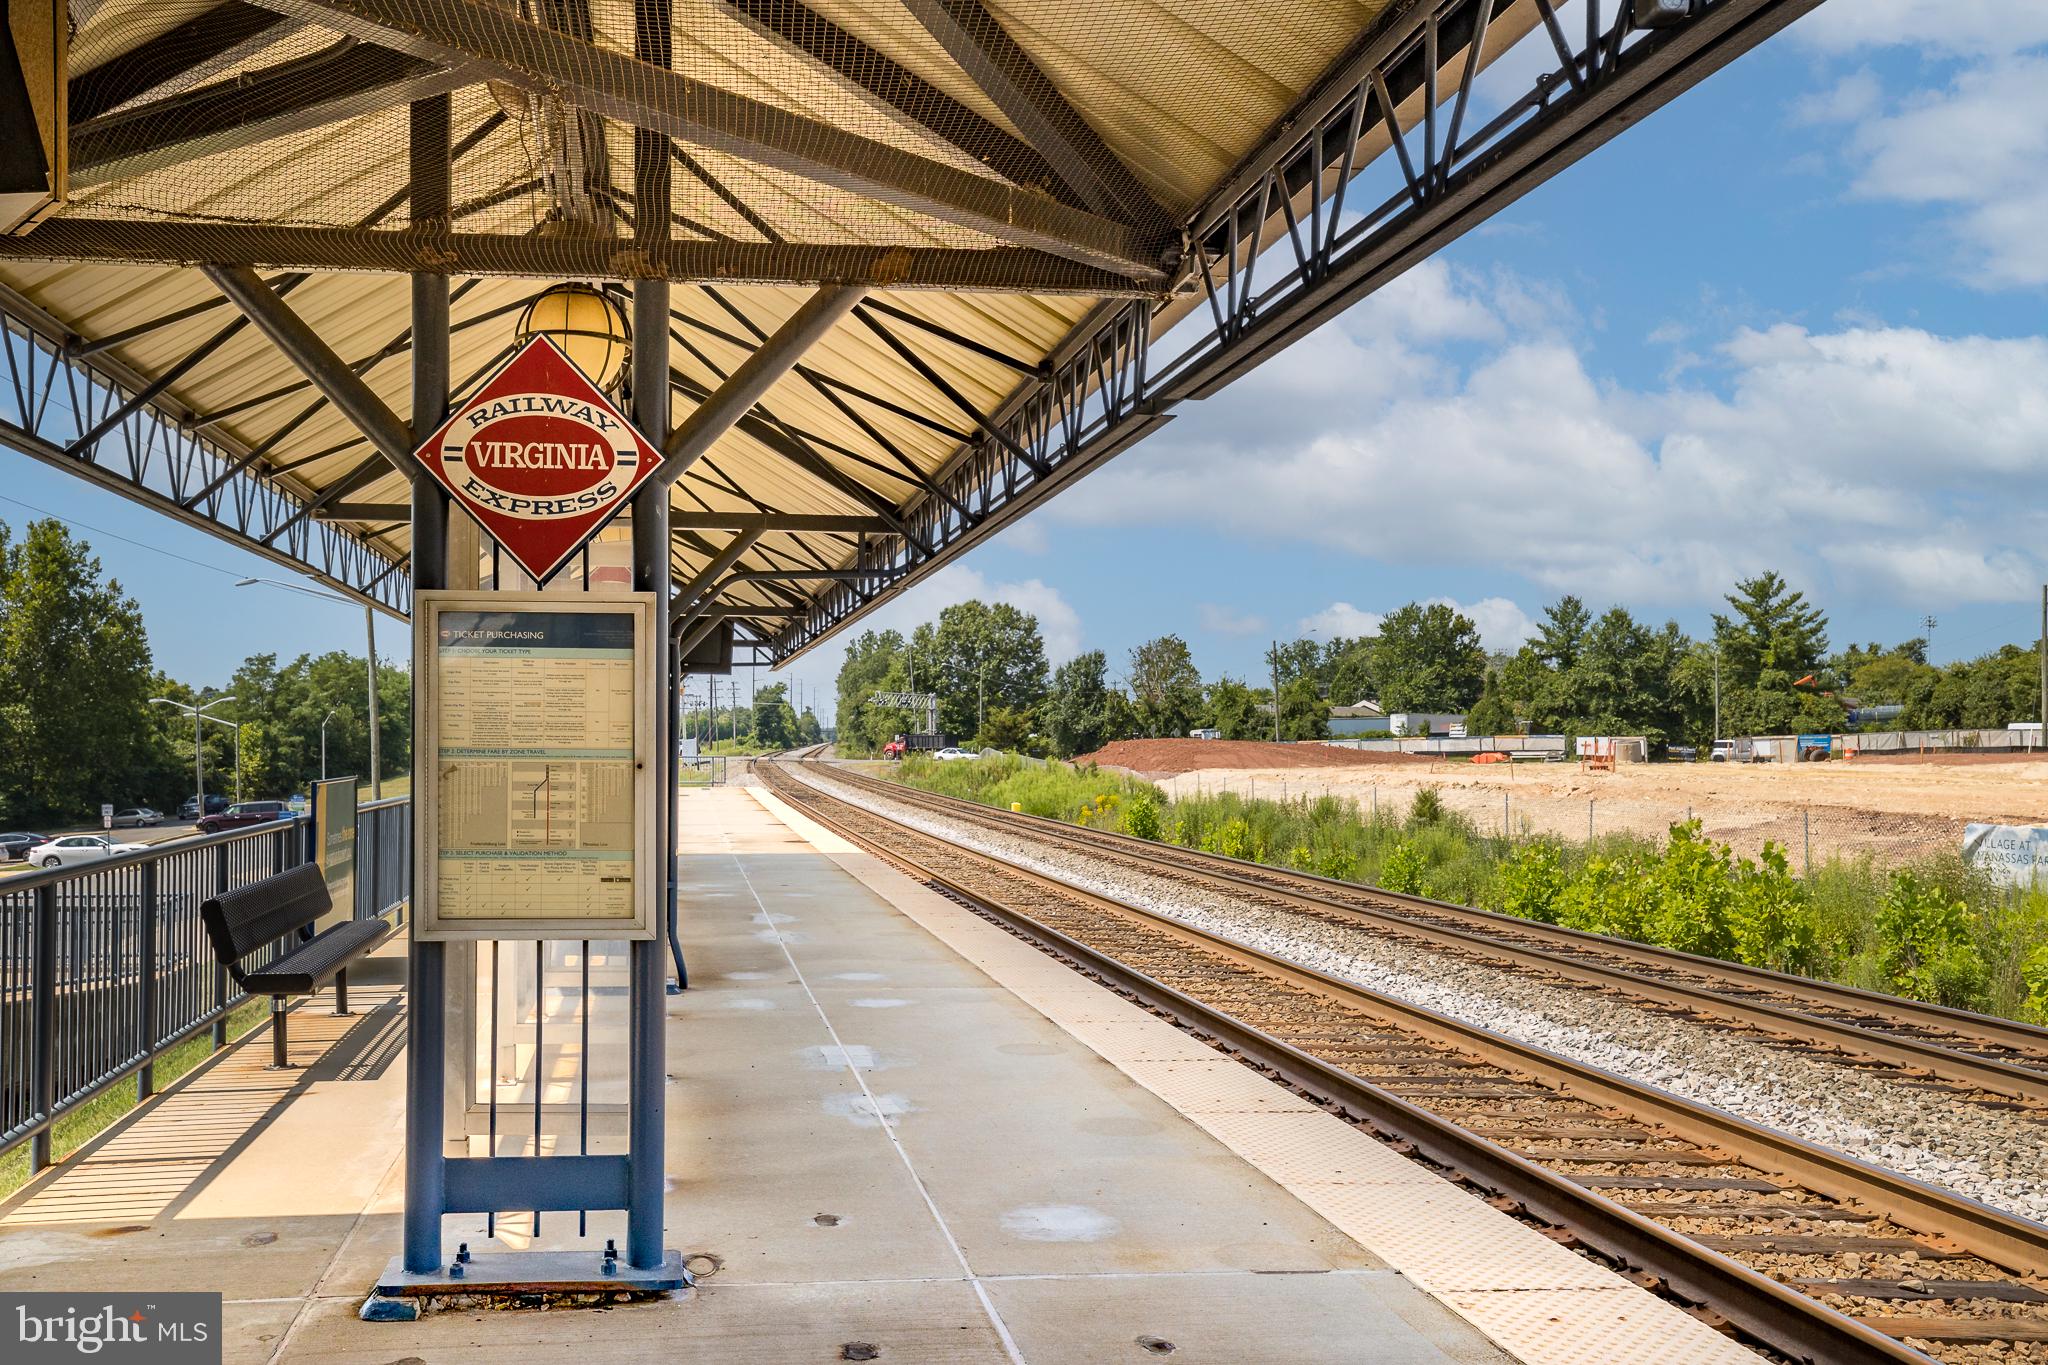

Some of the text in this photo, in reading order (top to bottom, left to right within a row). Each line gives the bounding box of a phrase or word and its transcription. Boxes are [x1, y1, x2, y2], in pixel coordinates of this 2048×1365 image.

[466, 397, 620, 432] RAILWAY
[470, 441, 609, 470] VIRGINIA
[462, 477, 617, 515] EXPRESS
[453, 630, 544, 640] TICKET PURCHASING
[1974, 839, 2032, 850] VILLAGE AT
[1976, 851, 2029, 865] MANASSAS
